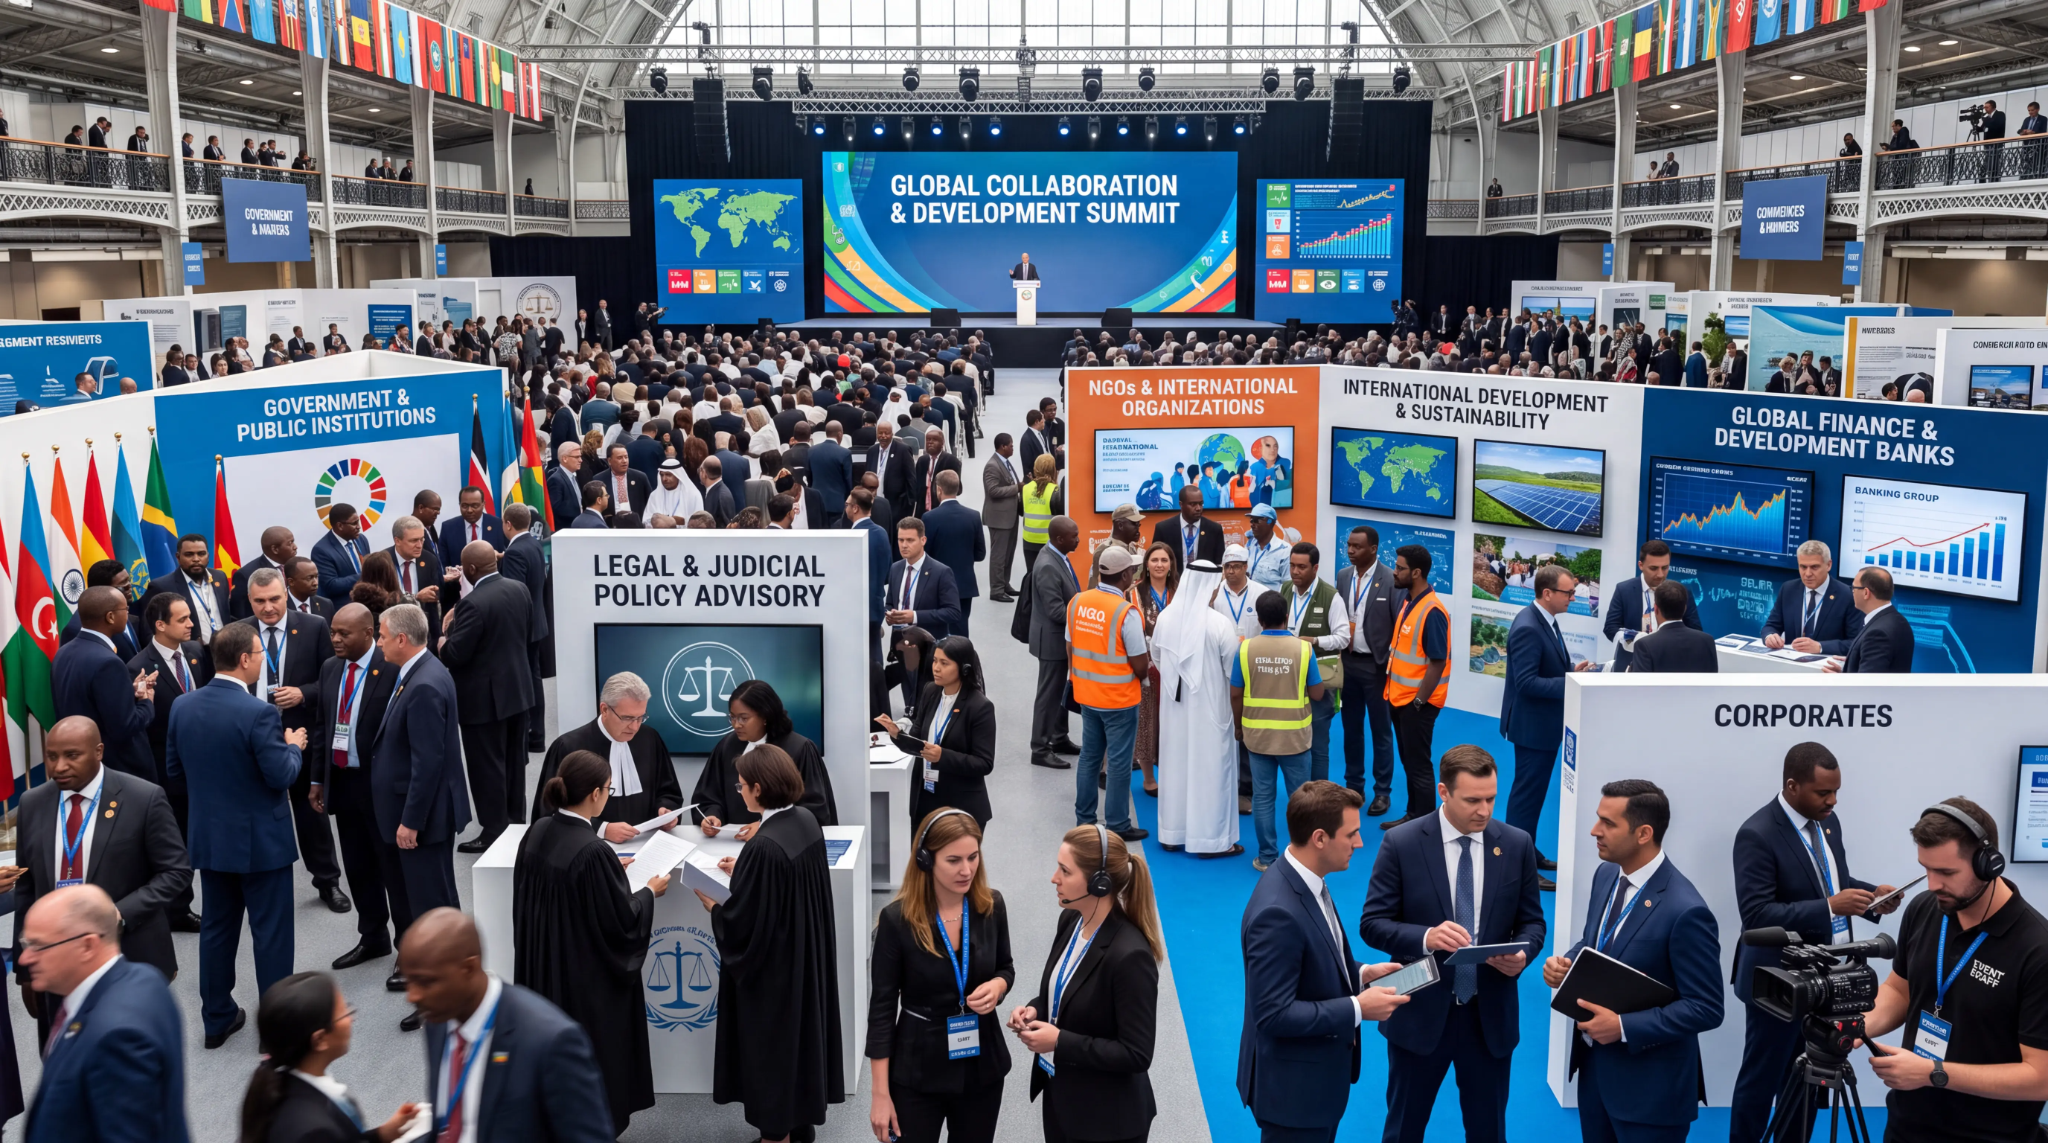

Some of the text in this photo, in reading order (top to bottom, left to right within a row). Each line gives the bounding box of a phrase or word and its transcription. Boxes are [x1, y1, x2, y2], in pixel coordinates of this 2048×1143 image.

[890, 174, 1178, 197] GLOBAL COLLABORATION
[890, 201, 1180, 224] & DEVELOPMENT SUMMIT
[252, 223, 258, 235] &
[1089, 377, 1298, 396] NGOs & INTERNATIONAL
[1344, 379, 1609, 413] INTERNATIONAL DEVELOPMENT
[264, 388, 410, 417] GOVERNMENT &
[1122, 399, 1265, 417] ORGANIZATIONS
[237, 406, 436, 442] PUBLIC INSTITUTIONS
[1396, 402, 1550, 430] & SUSTAINABILITY
[1732, 406, 1938, 441] GLOBAL FINANCE &
[1715, 427, 1955, 466] DEVELOPMENT BANKS
[1855, 486, 1939, 502] BANKING GROUP
[594, 554, 825, 577] LEGAL & JUDICIAL
[594, 584, 825, 607] POLICY ADVISORY
[1714, 703, 1893, 727] CORPORATES
